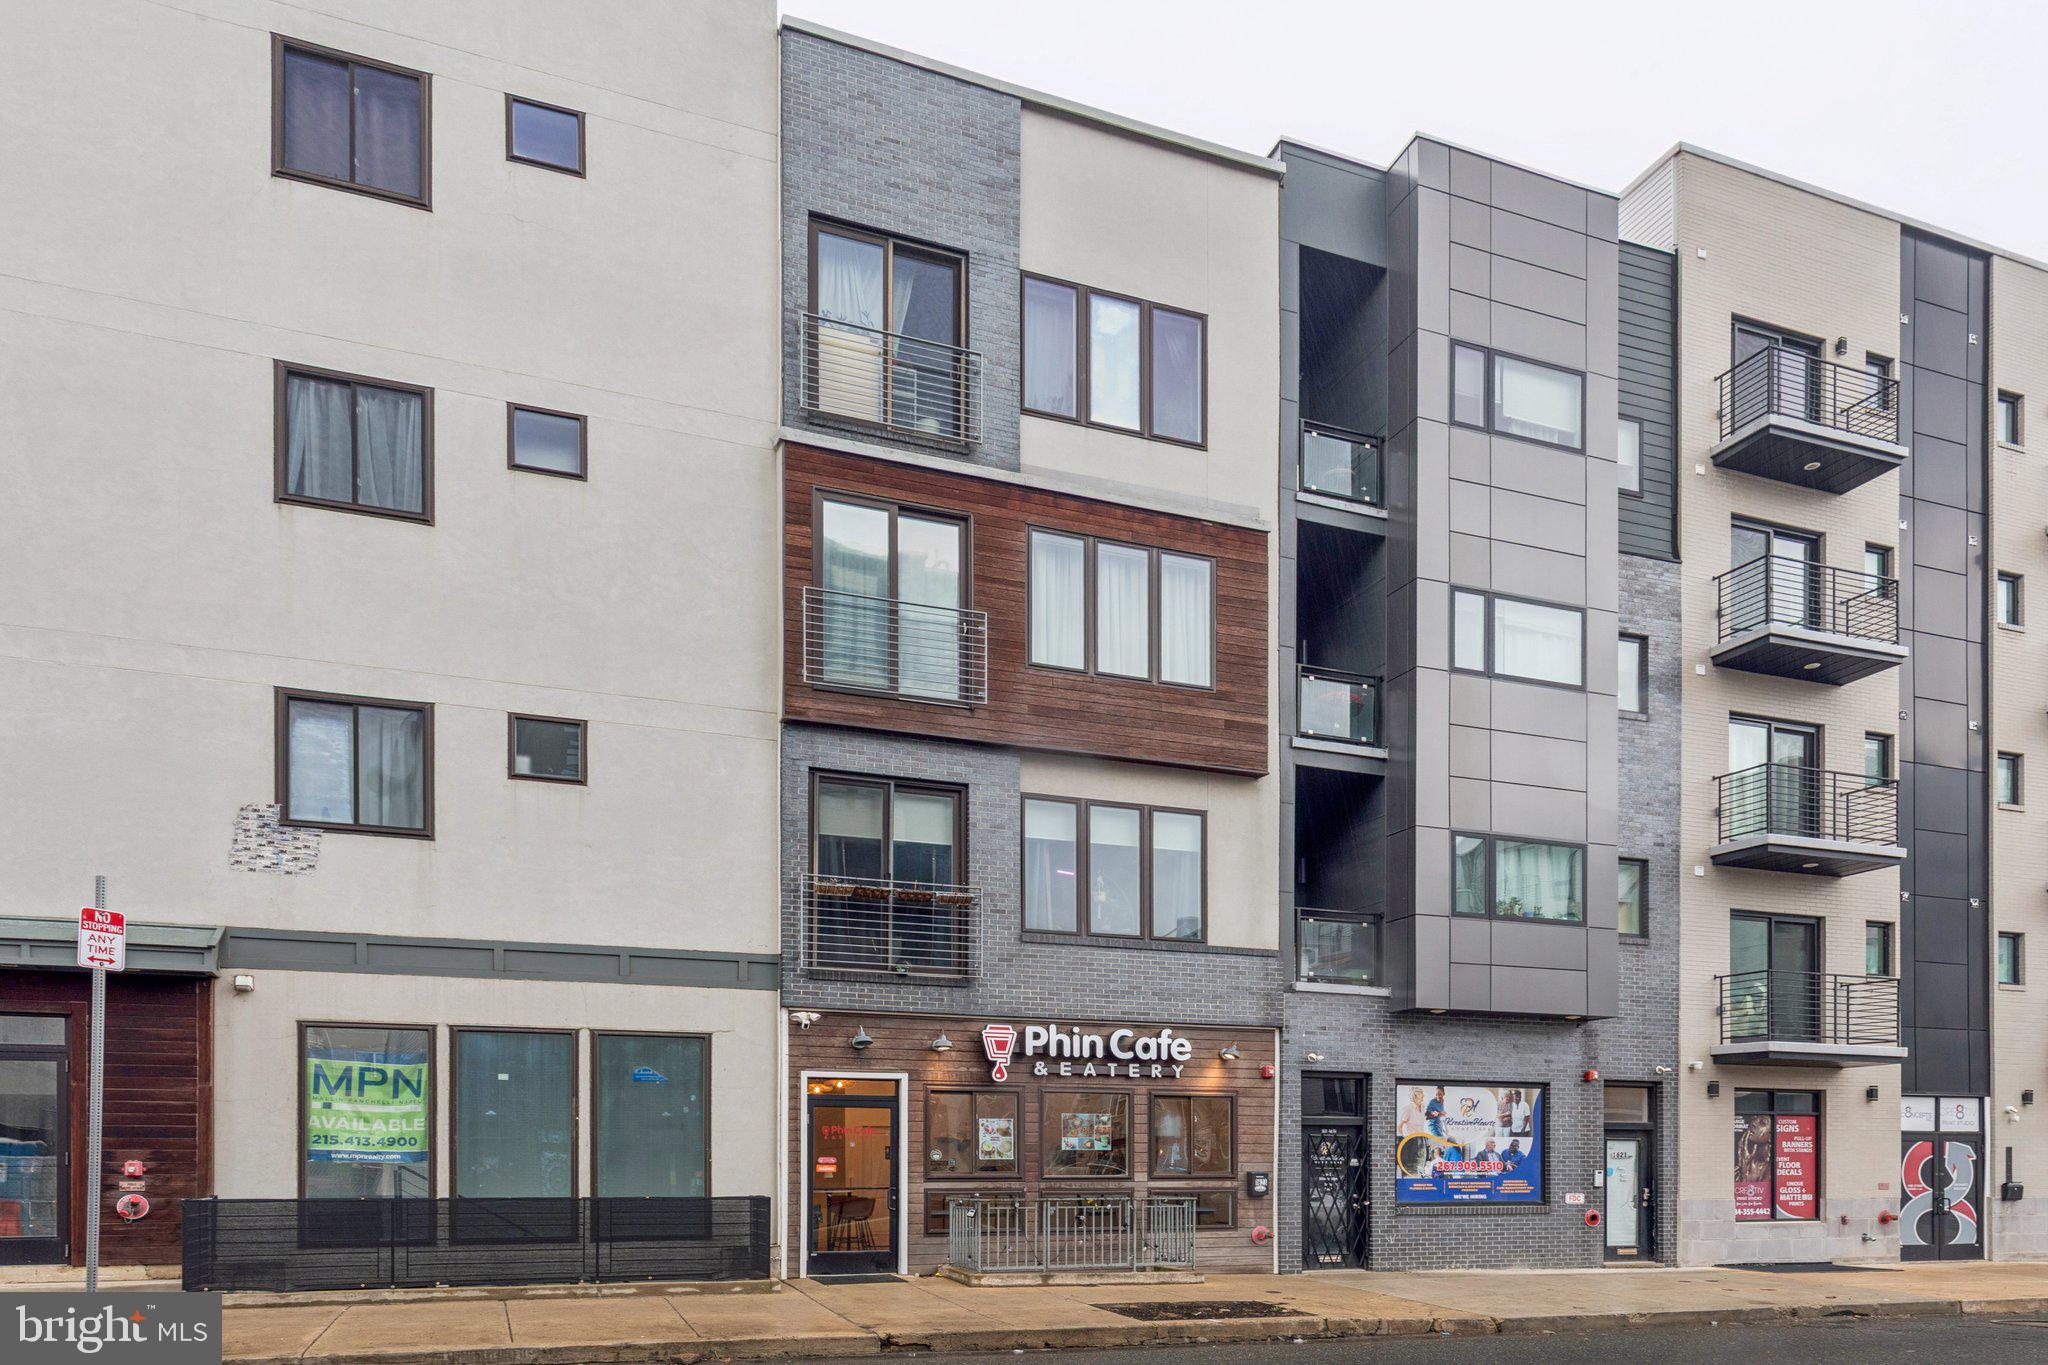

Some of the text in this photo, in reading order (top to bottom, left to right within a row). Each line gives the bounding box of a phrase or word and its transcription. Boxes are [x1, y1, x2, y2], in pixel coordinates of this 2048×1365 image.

[94, 911, 110, 923] NO
[82, 921, 123, 934] STOPPING
[88, 934, 116, 944] ANY
[87, 944, 116, 956] TIME
[1025, 1024, 1192, 1061] Phin Cafe
[1034, 1061, 1184, 1078] & EATERY
[312, 1064, 423, 1099] MPN
[308, 1115, 425, 1132] AVAILABLE
[1776, 1124, 1800, 1133] SIGNS
[312, 1134, 418, 1147] 215.413.4900
[330, 1152, 401, 1160] www.mpnrealty.com
[1436, 1162, 1504, 1171] 267.909.5510
[1568, 1194, 1582, 1202] FDC
